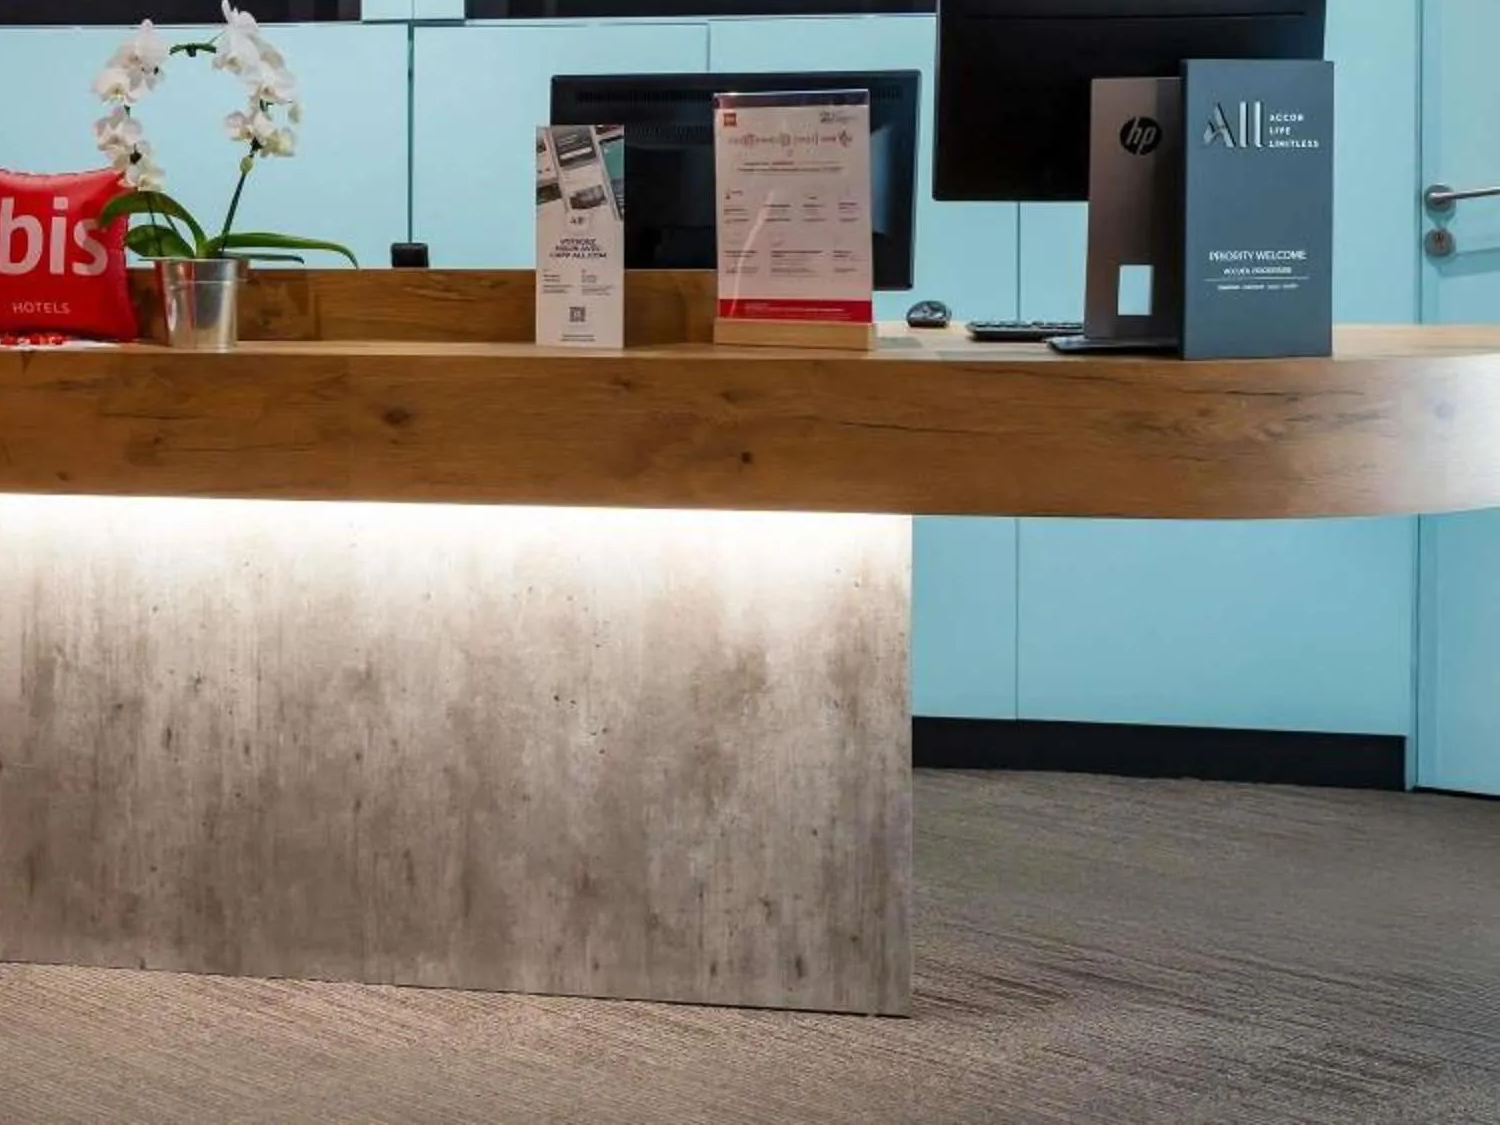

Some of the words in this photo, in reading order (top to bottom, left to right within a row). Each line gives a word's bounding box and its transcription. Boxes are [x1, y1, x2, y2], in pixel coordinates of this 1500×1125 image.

[1269, 112, 1305, 122] ACCOR
[1125, 116, 1159, 156] hp
[1269, 126, 1291, 136] LIVE
[1268, 138, 1320, 148] LIMITLESS
[1208, 250, 1254, 261] PRIORITY
[1255, 250, 1308, 260] WELCOME
[12, 300, 71, 315] HOTELS
